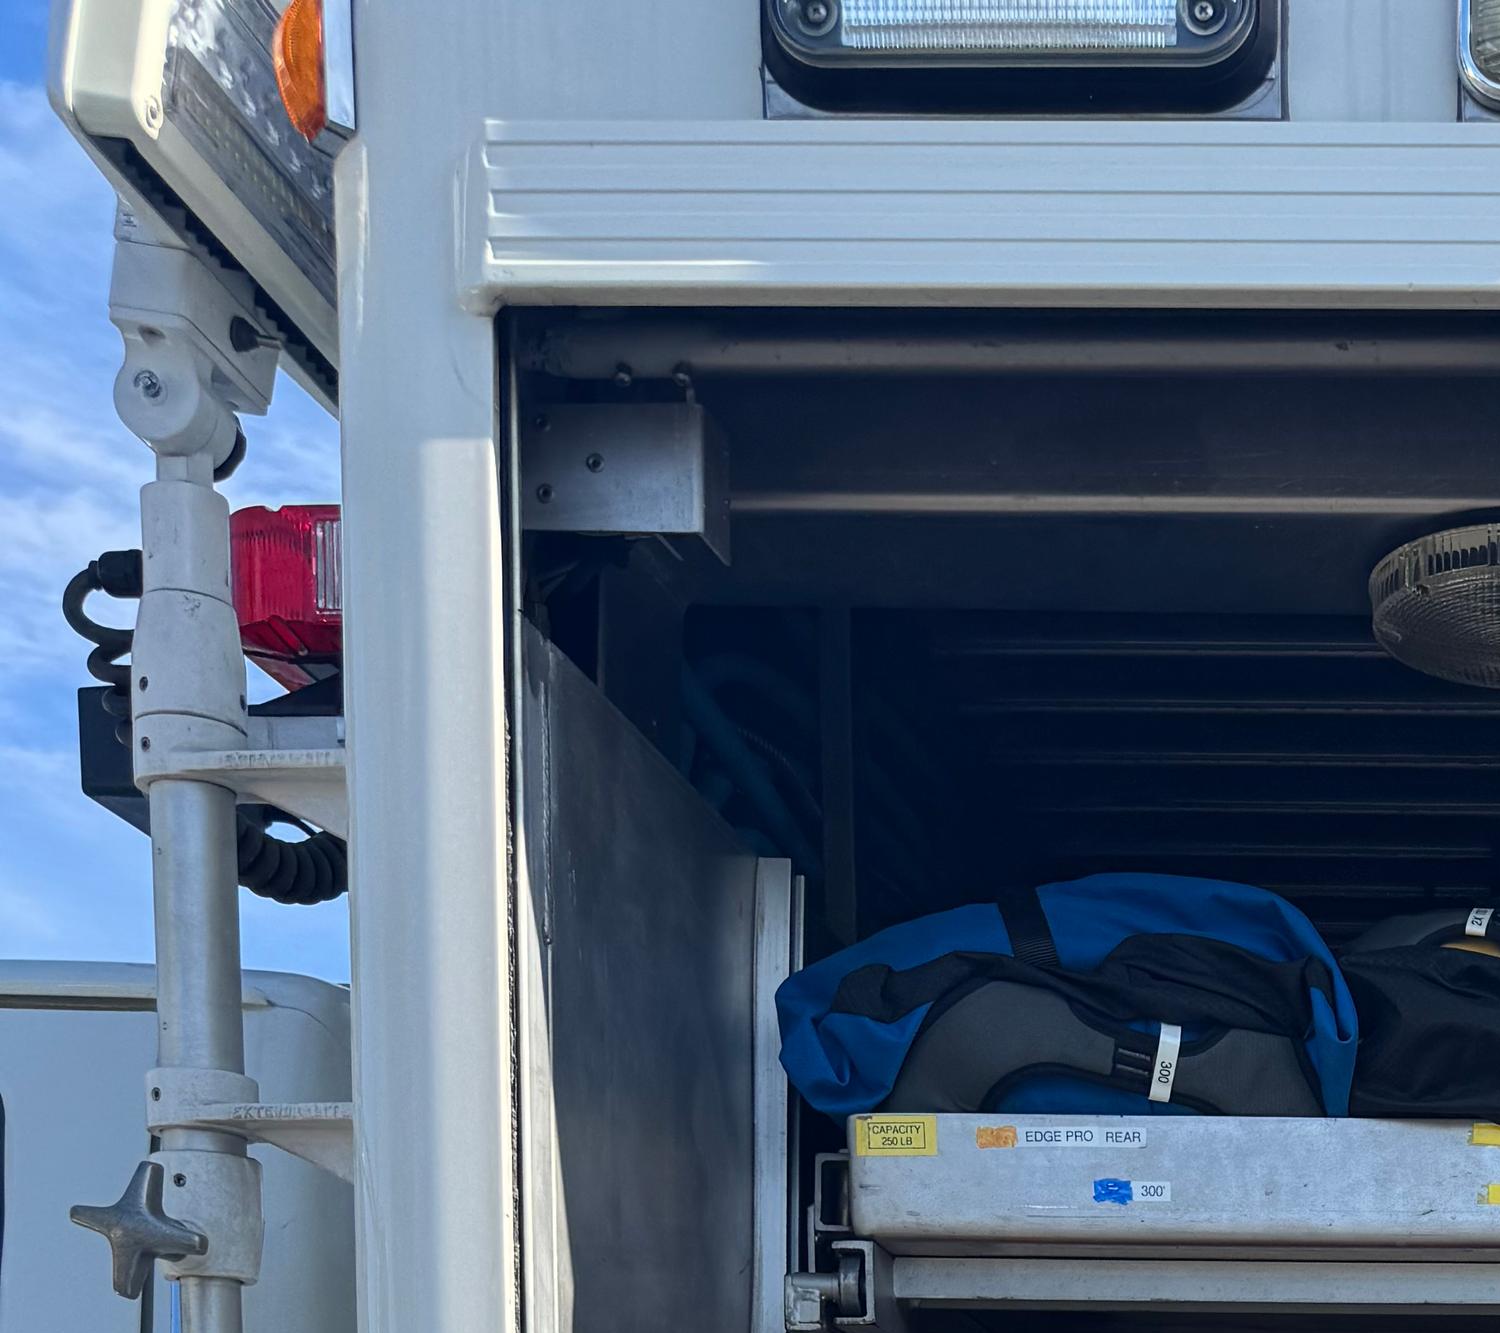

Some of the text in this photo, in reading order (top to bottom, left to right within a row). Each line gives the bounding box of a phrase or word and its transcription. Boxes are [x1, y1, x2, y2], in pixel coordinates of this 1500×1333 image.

[1158, 1061, 1172, 1083] 300
[871, 1124, 921, 1135] CAPACITY
[882, 1137, 913, 1146] 250 LB
[1025, 1131, 1142, 1143] EDGE PRO REAR
